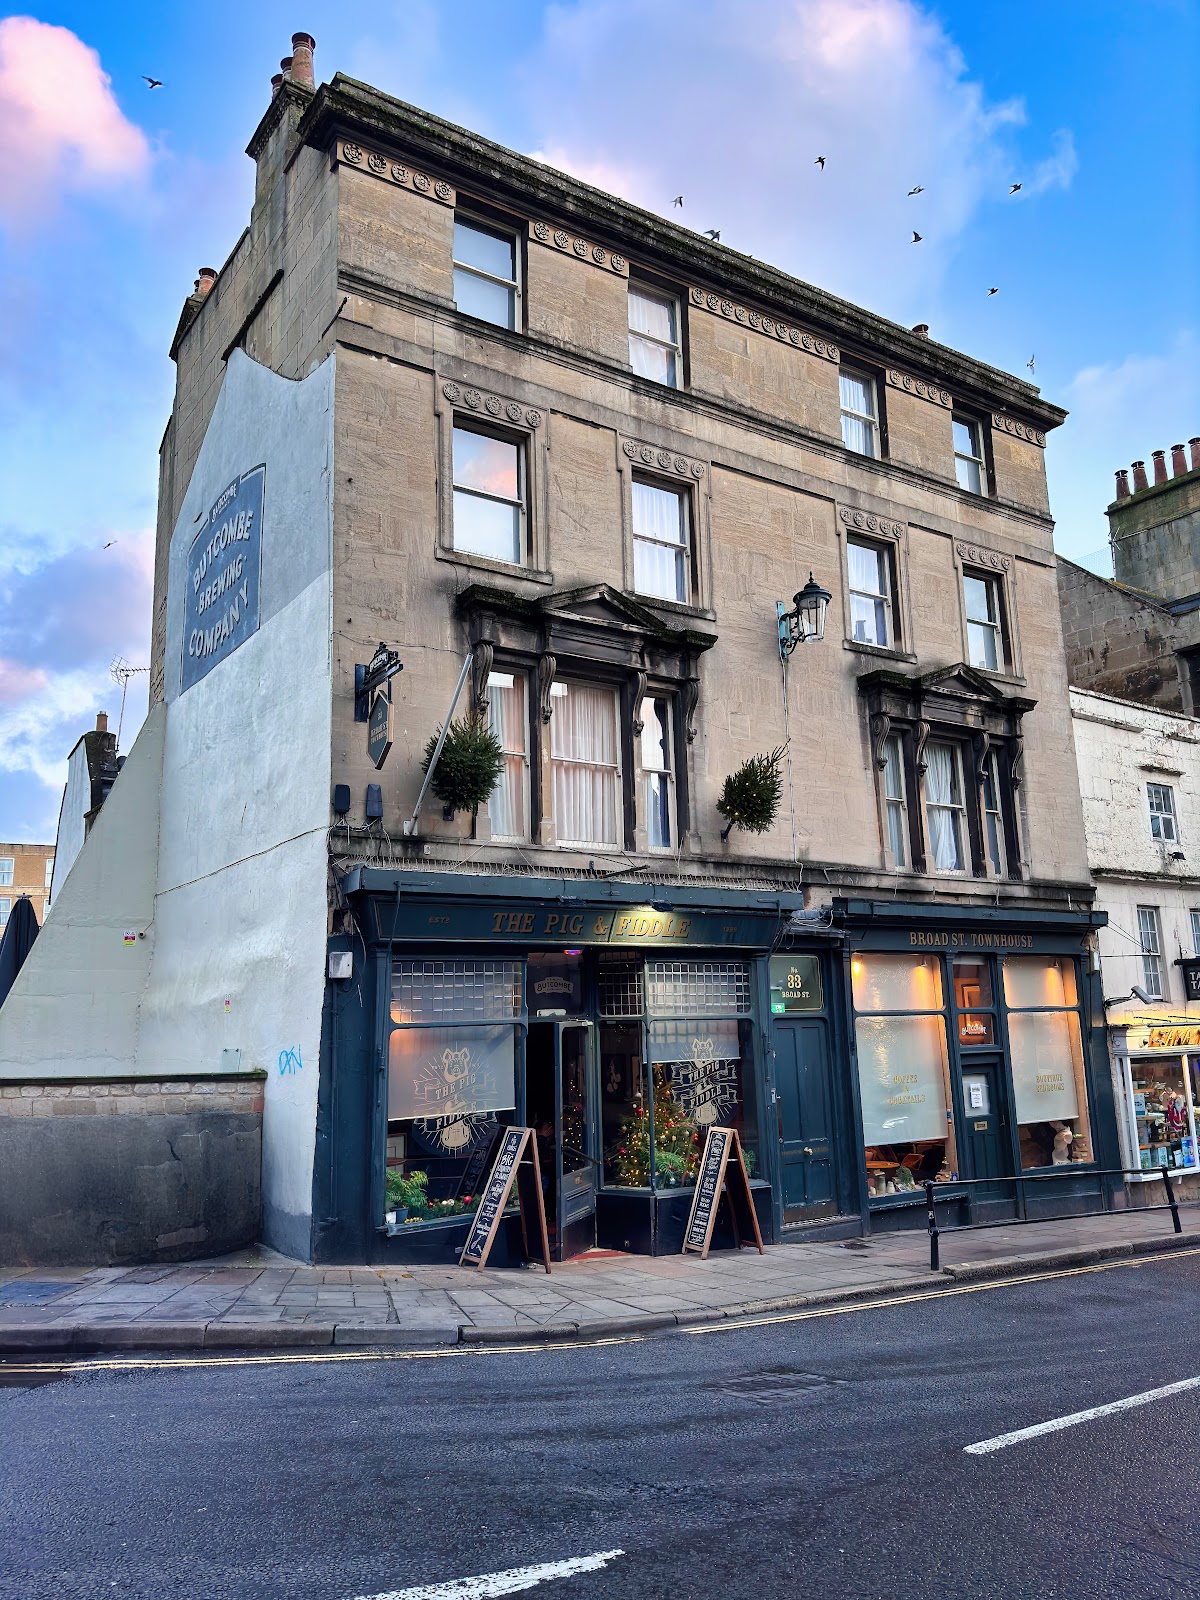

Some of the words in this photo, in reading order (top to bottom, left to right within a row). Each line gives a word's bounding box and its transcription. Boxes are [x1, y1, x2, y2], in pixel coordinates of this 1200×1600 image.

[193, 510, 253, 594] BUTCOMBE
[198, 553, 244, 616] BREWING
[189, 577, 249, 658] COMPANY
[492, 912, 537, 934] THE
[543, 914, 585, 936] PIG
[593, 915, 609, 936] &
[615, 915, 692, 939] FIDDLE
[909, 931, 949, 946] BROAD
[951, 933, 968, 946] ST.
[970, 933, 1033, 948] TOWNHOUSE
[536, 981, 571, 991] BUTCOMBE
[787, 974, 802, 989] 33
[688, 1067, 705, 1083] THE
[706, 1060, 720, 1074] PIG
[435, 1082, 456, 1100] THE
[459, 1073, 477, 1090] PIG
[690, 1085, 721, 1109] FIDDLE
[436, 1101, 478, 1131] FIDDLE
